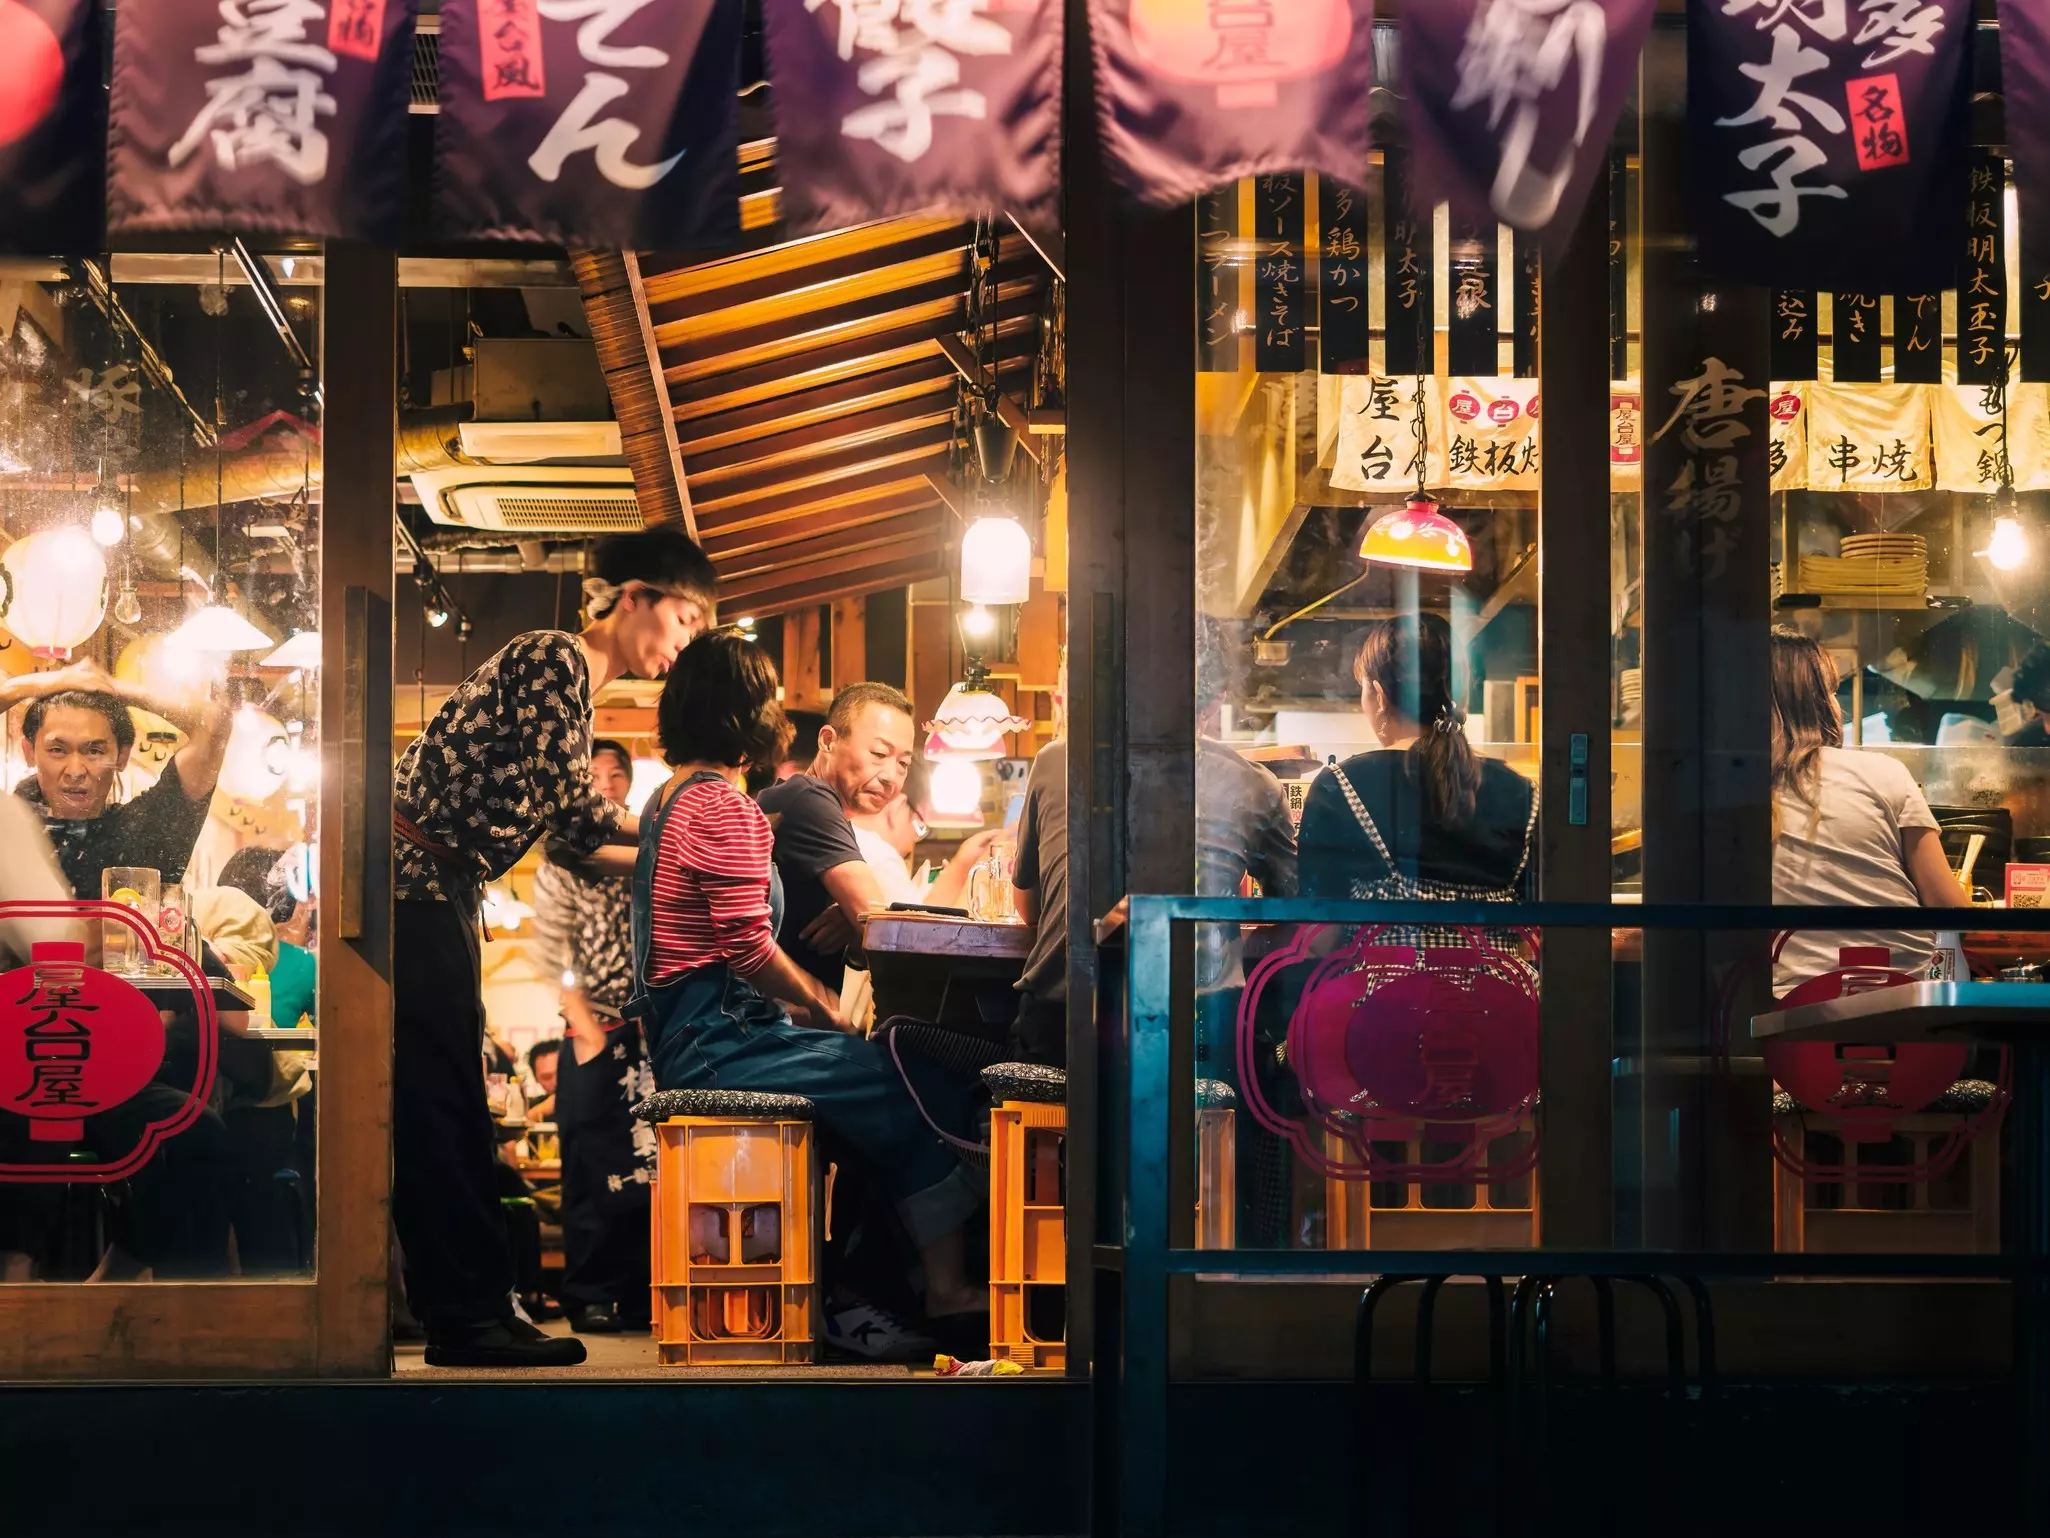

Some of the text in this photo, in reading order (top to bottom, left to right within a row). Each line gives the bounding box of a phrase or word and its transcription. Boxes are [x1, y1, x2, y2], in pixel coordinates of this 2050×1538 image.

[1855, 85, 1904, 161] 名物
[1966, 166, 1999, 365] 鉄板明太玉子
[1777, 288, 1808, 341] 込み
[1906, 294, 1937, 351] でん
[1358, 376, 1400, 480] 屋台
[1615, 408, 1637, 447] 屋台屋
[1647, 355, 1769, 582] 唐揚げ
[1828, 433, 1919, 483] 串焼
[1973, 384, 2014, 485] もつ鍋
[15, 967, 101, 1108] 屋台屋
